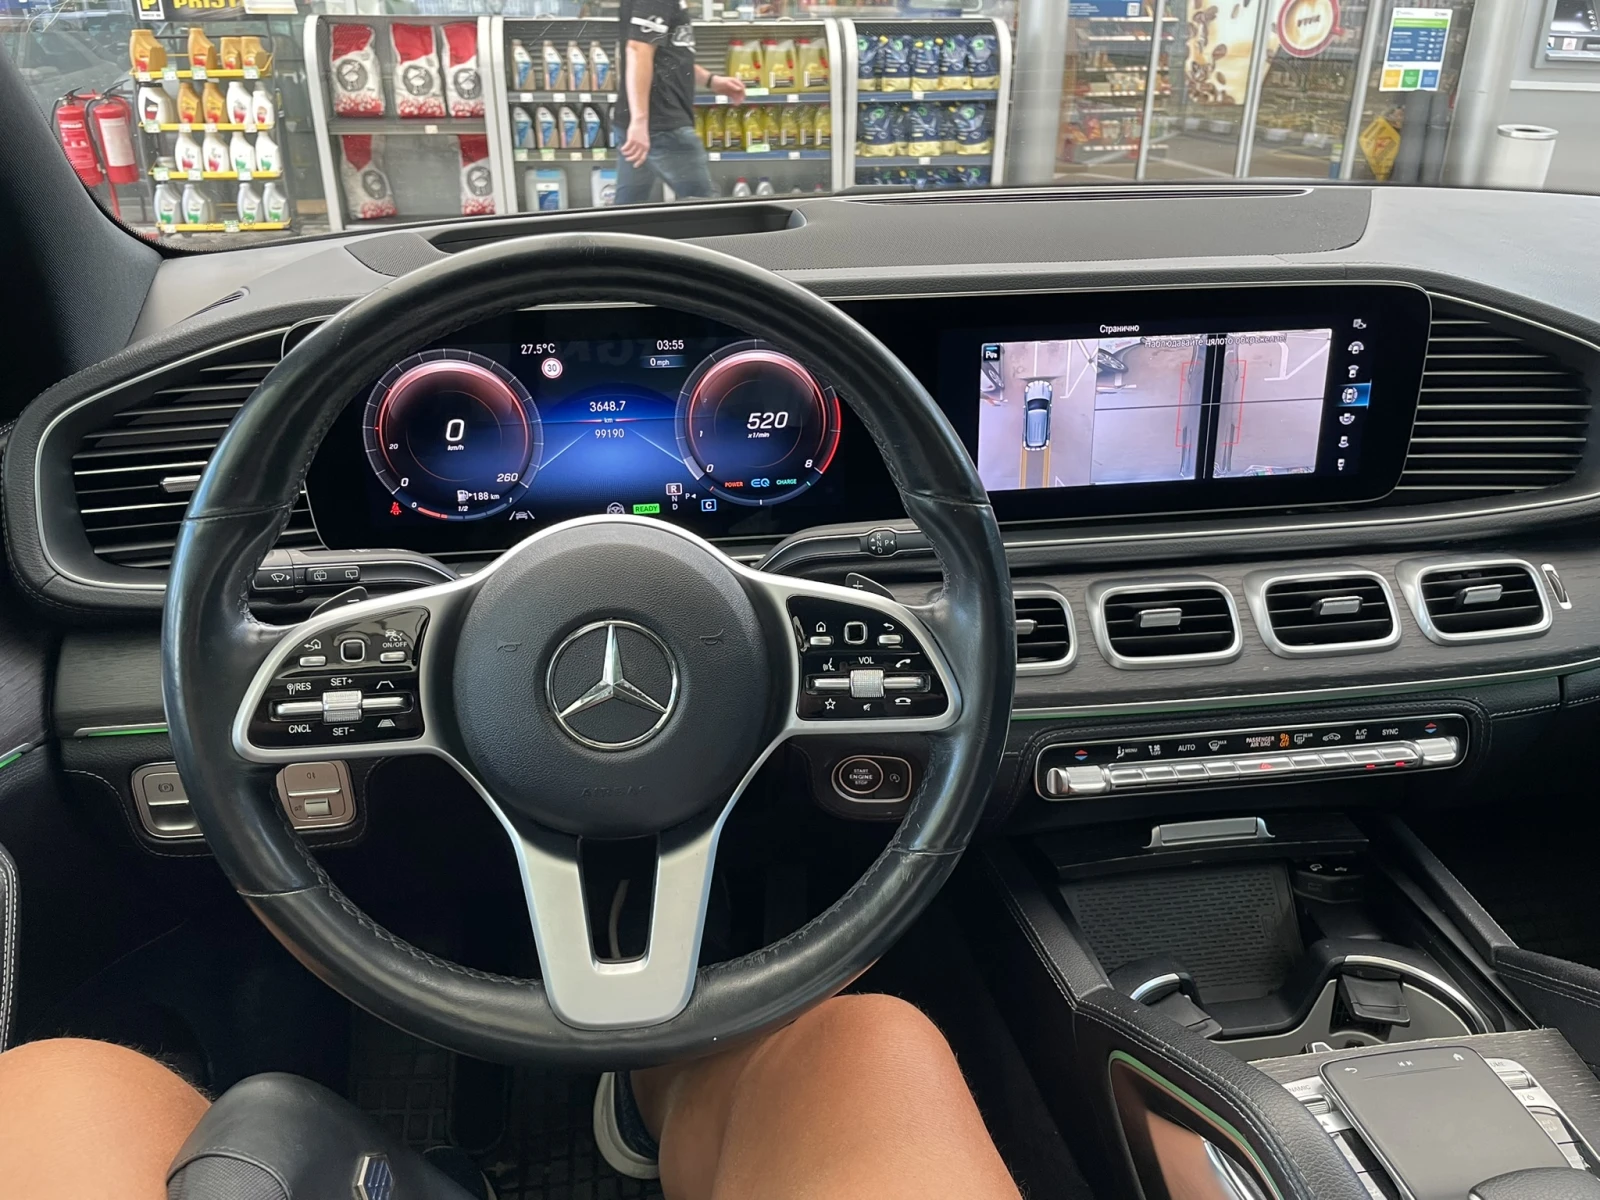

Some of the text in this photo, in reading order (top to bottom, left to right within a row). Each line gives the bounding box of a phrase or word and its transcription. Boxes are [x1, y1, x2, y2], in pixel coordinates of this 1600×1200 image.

[1099, 324, 1140, 334] Странично
[656, 339, 685, 351] 03:55
[1205, 336, 1234, 346] цялото
[520, 343, 556, 355] 27.5°C
[649, 357, 670, 367] 0 mph
[546, 363, 558, 373] 30
[589, 400, 626, 412] 3648.7
[746, 411, 789, 430] 520
[445, 418, 465, 442] 0
[594, 428, 625, 439] 99190
[705, 463, 714, 473] 0
[804, 459, 814, 468] 8
[400, 477, 409, 487] 0
[496, 472, 519, 483] 260
[750, 477, 771, 488] EQ
[775, 478, 798, 486] CHARGE
[670, 485, 678, 494] R
[473, 491, 489, 500] 188
[635, 505, 658, 513] READY
[672, 503, 679, 511] D
[705, 501, 713, 509] C
[876, 532, 882, 540] R
[382, 641, 408, 649] ON/OFF
[858, 656, 874, 665] VOL
[330, 677, 353, 687] SET+
[288, 724, 312, 734] CNCL
[1354, 728, 1368, 736] A/C
[1381, 727, 1399, 736] SYNC
[1245, 735, 1275, 744] PASSENGER
[1177, 743, 1196, 752] AUTO
